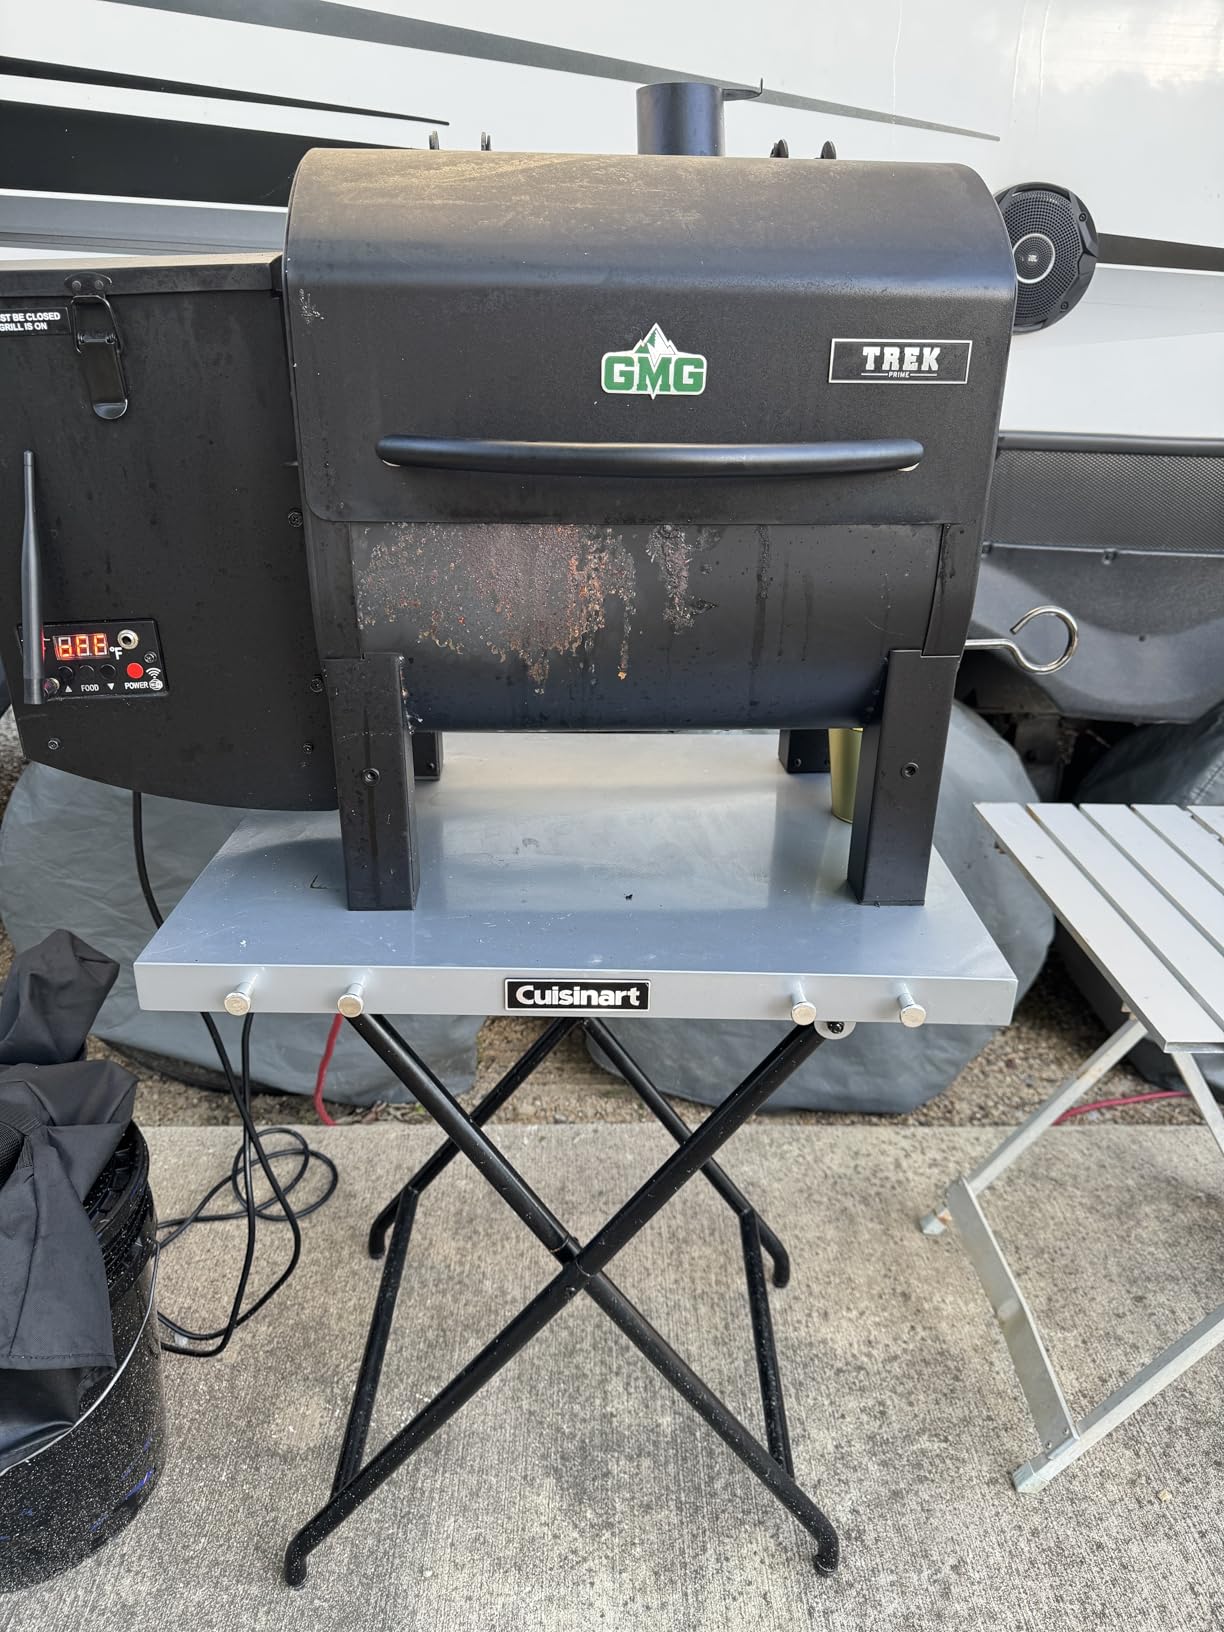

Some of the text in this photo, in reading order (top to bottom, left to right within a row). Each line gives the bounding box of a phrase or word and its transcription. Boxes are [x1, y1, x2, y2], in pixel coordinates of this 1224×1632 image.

[12, 313, 25, 322] BE
[25, 312, 61, 321] CLOSED
[0, 321, 48, 331] GRILL IS ON
[862, 346, 941, 371] TREK
[604, 355, 704, 393] GMG
[80, 683, 99, 692] FOOD
[124, 681, 149, 690] POWER
[516, 985, 640, 1007] Cuisinart
